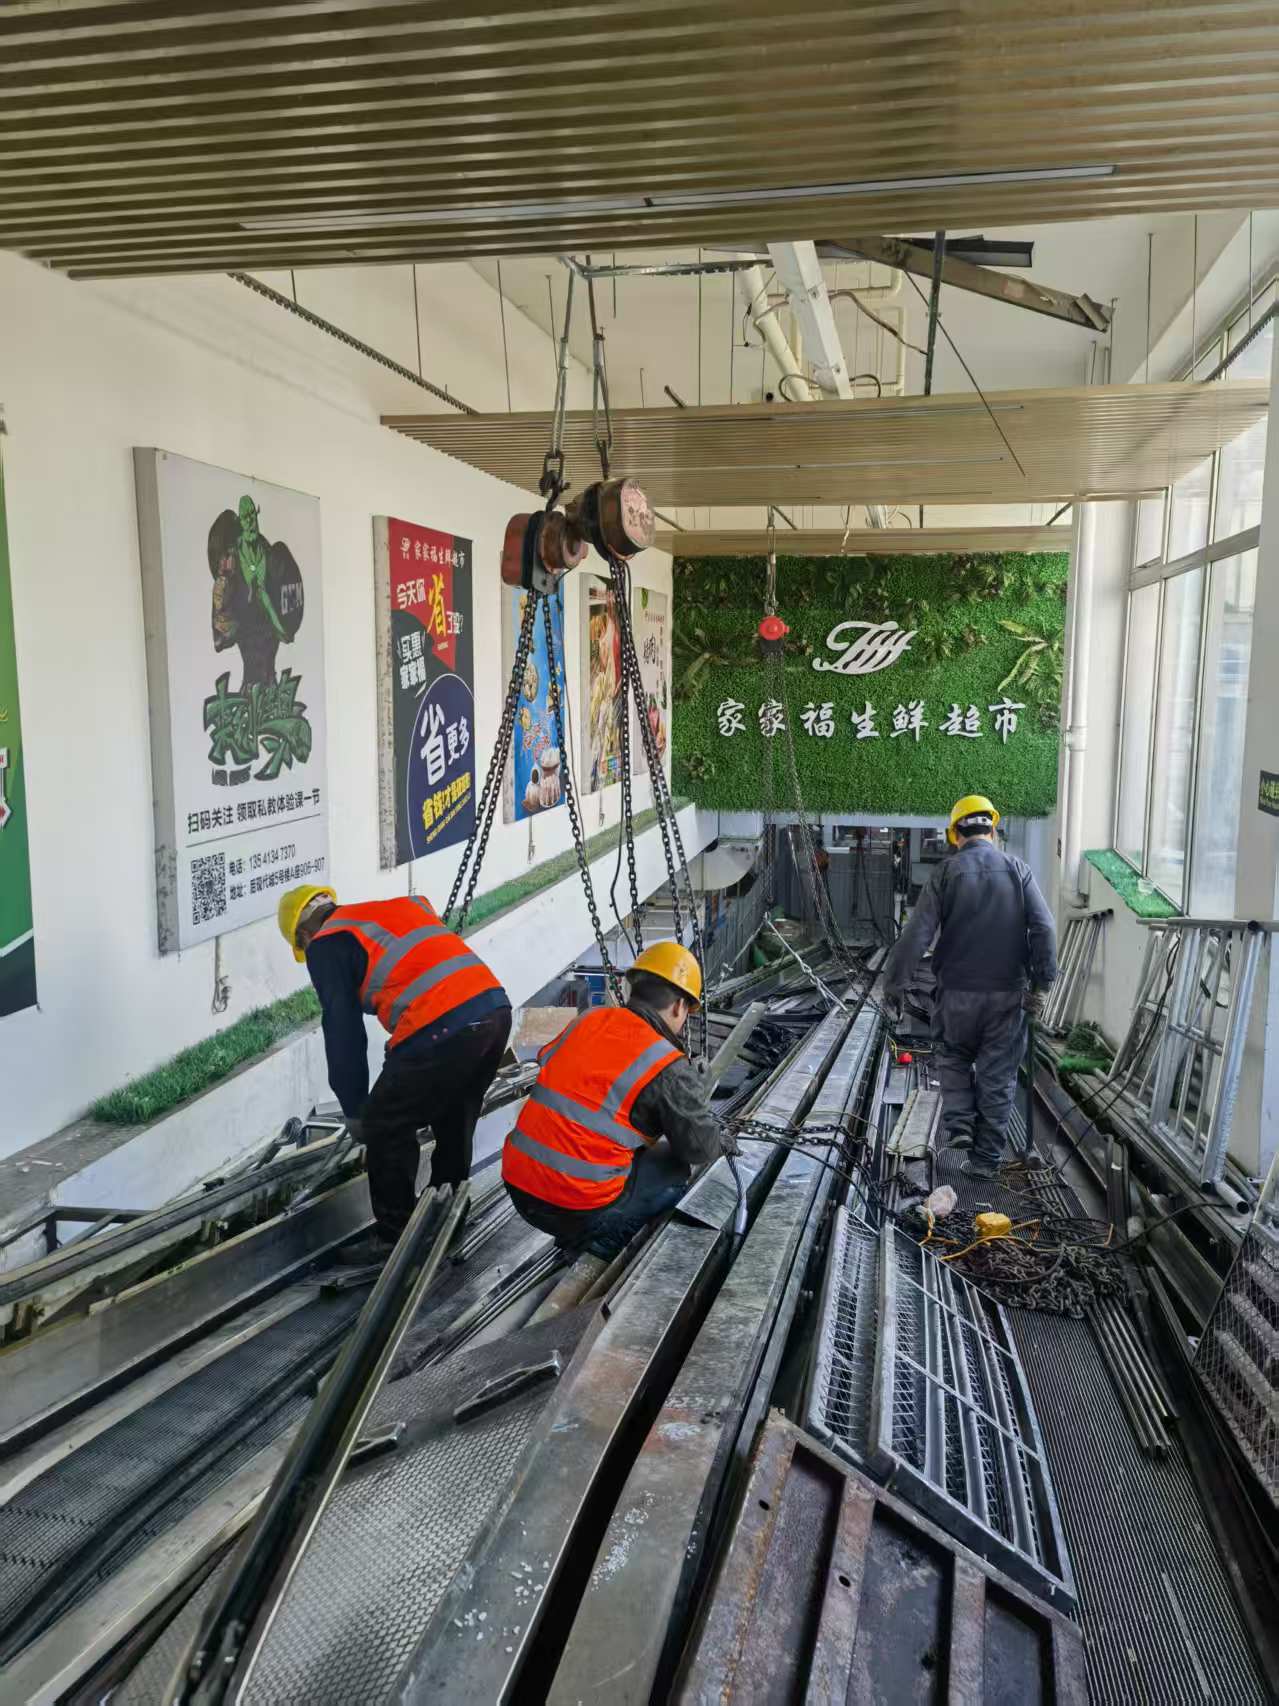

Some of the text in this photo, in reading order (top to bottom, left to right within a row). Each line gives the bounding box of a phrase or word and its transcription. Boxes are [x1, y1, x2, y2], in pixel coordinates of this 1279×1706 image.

[401, 631, 423, 663] 实惠
[716, 697, 1026, 744] 家家福生鲜超市
[187, 788, 320, 834] 扫码关注 领取私教体验课一节
[249, 854, 261, 871] 135
[263, 848, 278, 865] 4134
[280, 844, 296, 860] 7370
